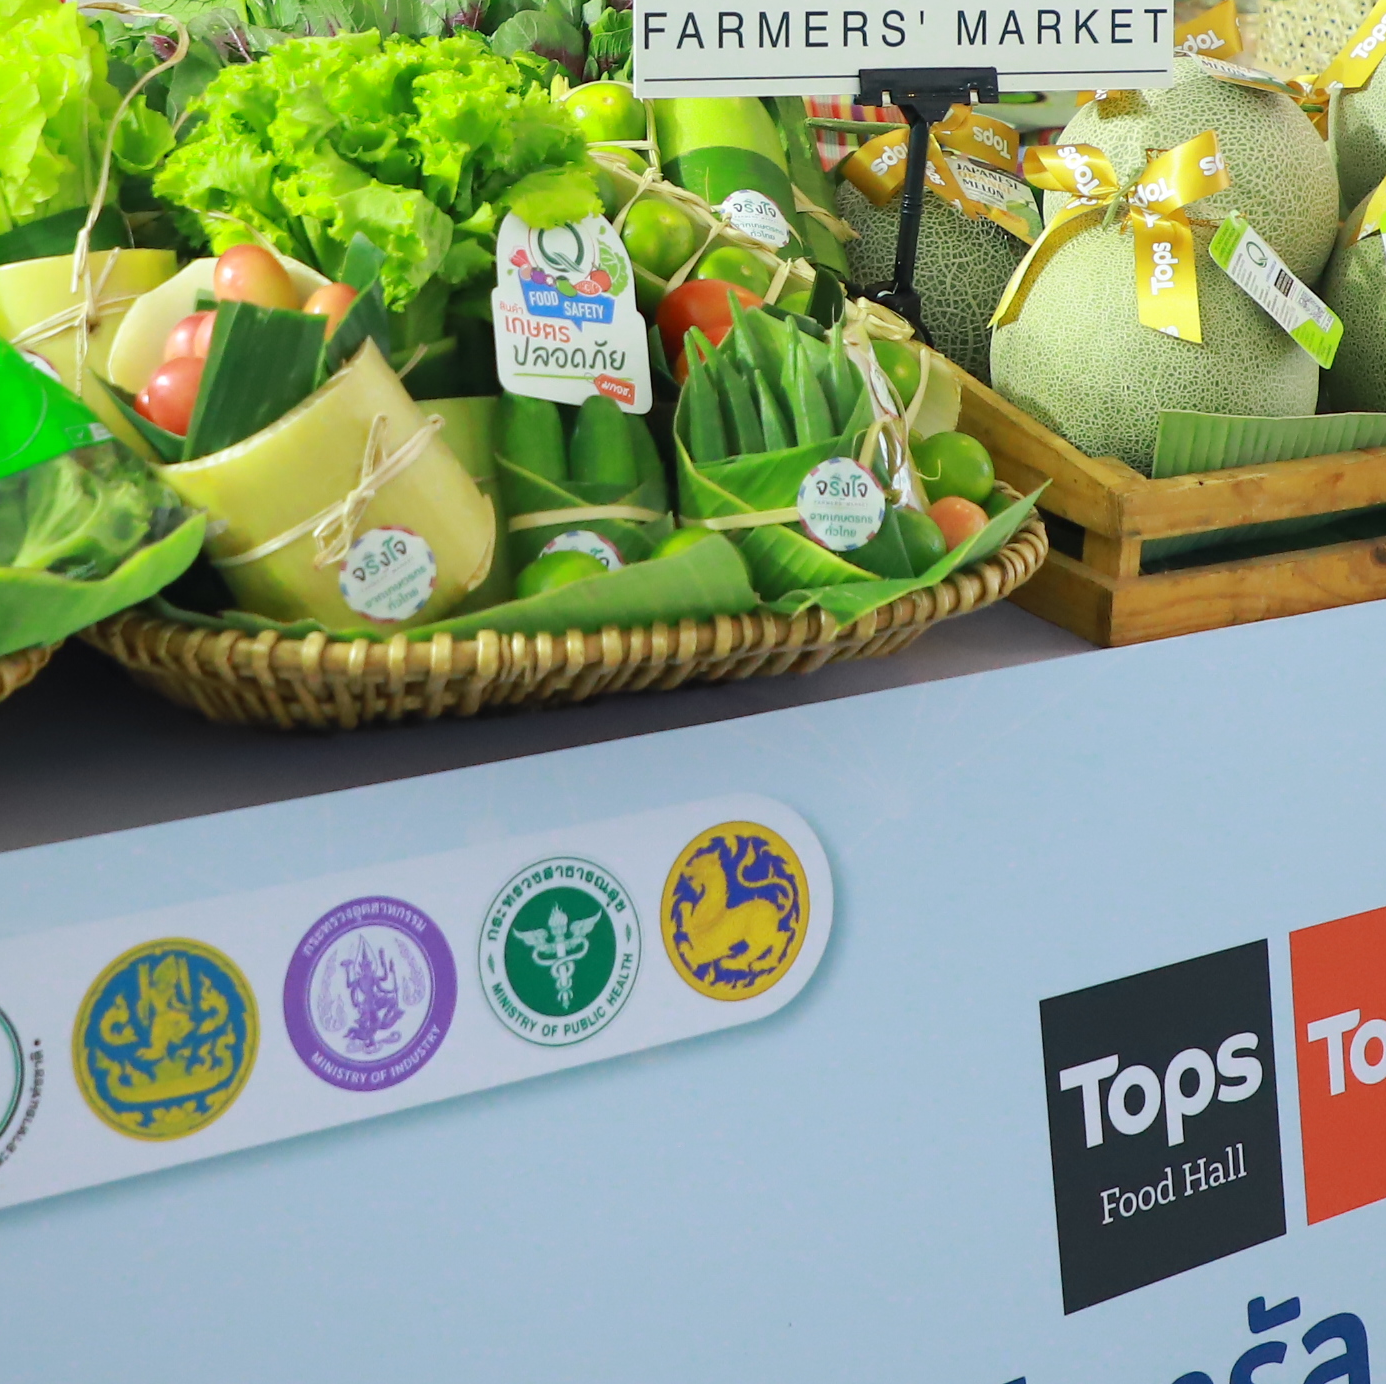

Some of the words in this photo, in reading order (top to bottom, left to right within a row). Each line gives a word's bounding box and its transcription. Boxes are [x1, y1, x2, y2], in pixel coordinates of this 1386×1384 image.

[643, 10, 926, 49] FARMERS'
[957, 8, 1168, 46] MARKET
[870, 142, 909, 177] ops
[972, 125, 1012, 160] Tops
[956, 162, 1021, 192] JAPANESE
[957, 171, 1014, 196] ORANGE
[1057, 145, 1101, 197] Tops
[962, 178, 1005, 200] MELON
[1151, 240, 1179, 296] Tops
[499, 300, 524, 315] สินค้า
[528, 290, 559, 307] FOOD
[564, 301, 604, 320] SAFETY
[504, 315, 571, 344] เกษตร
[513, 336, 627, 371] ปลอดภัย
[601, 380, 632, 398] มกอช.
[815, 473, 868, 498] จริงใจ
[809, 512, 873, 524] จากเกษตรกร
[303, 902, 427, 957] กระทรวงอุตสาหกรรม
[491, 981, 539, 1033] MINISTRY
[541, 1024, 559, 1037] OF
[563, 1005, 606, 1037] PUBLIC
[606, 952, 634, 1007] HEALTH
[310, 1050, 368, 1084] MINISTRY
[370, 1069, 387, 1083] OF
[390, 1023, 441, 1078] INDUSTRY
[1058, 1031, 1264, 1149] Tops
[1099, 1166, 1177, 1226] Food
[1181, 1141, 1249, 1198] Hall
